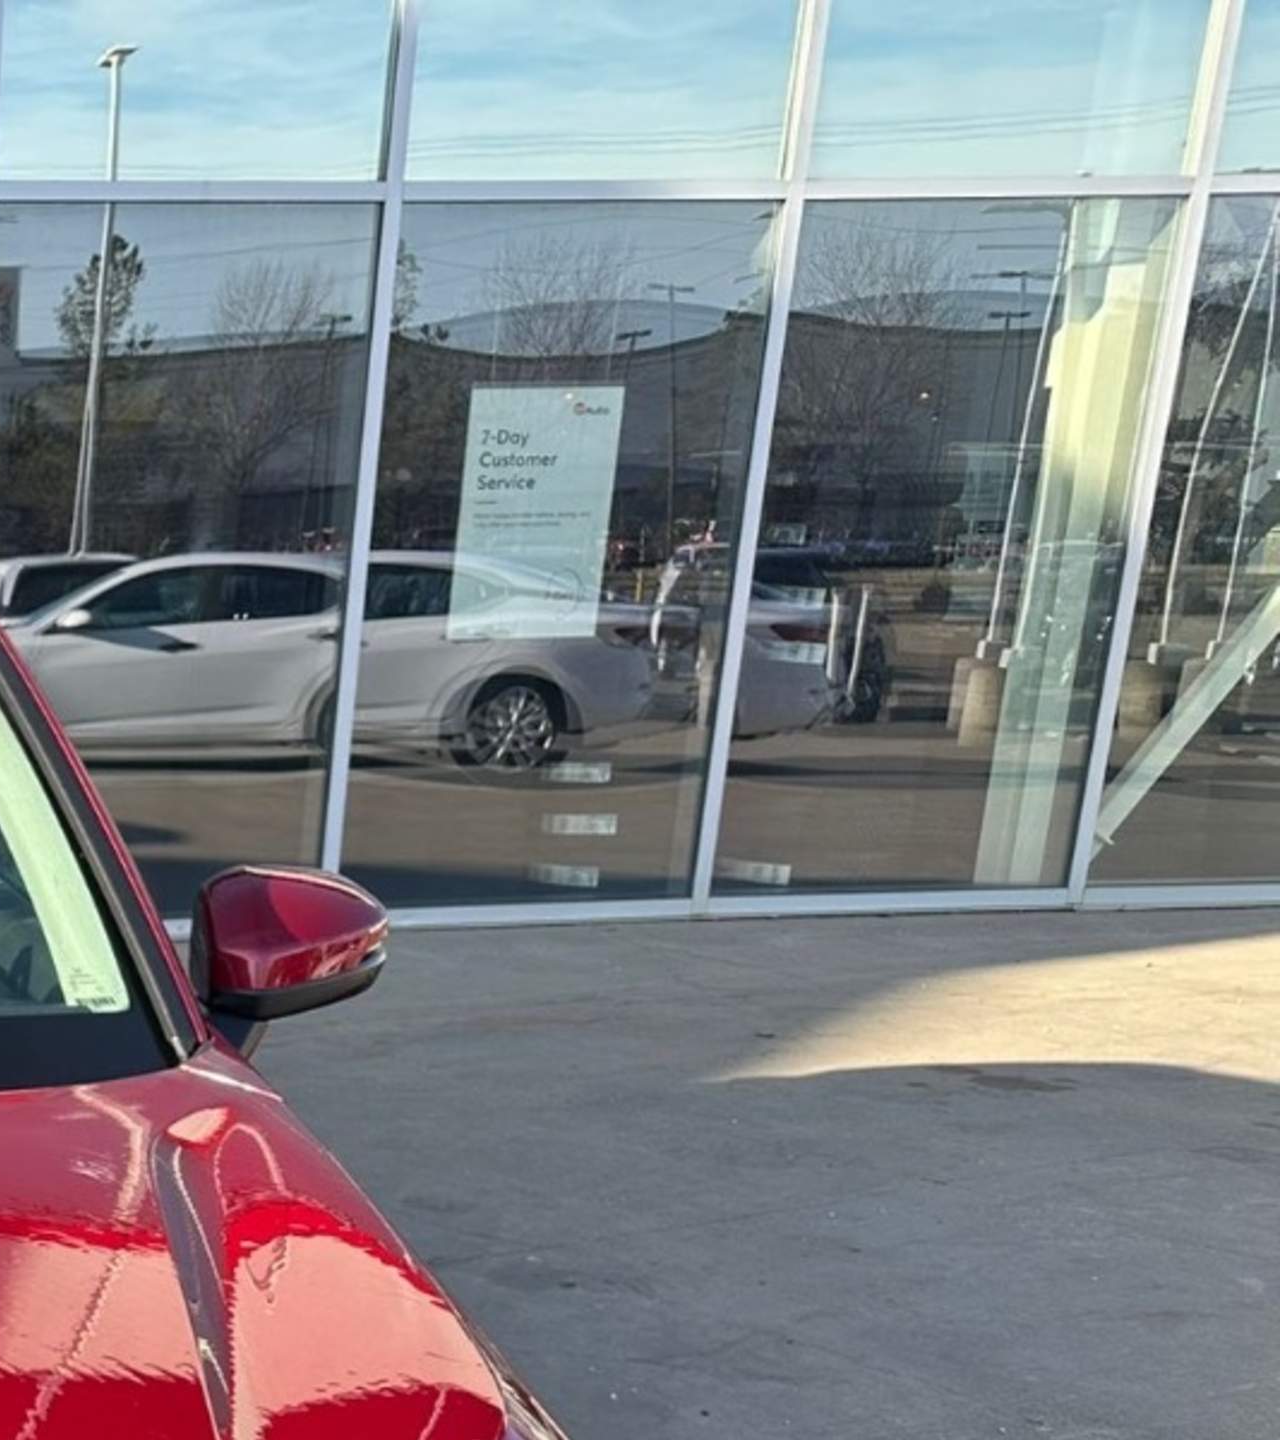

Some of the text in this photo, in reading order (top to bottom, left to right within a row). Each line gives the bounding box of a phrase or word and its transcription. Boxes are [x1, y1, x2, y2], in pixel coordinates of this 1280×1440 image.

[481, 429, 529, 448] 7-Day
[478, 451, 558, 468] Customer
[476, 474, 537, 490] Service
